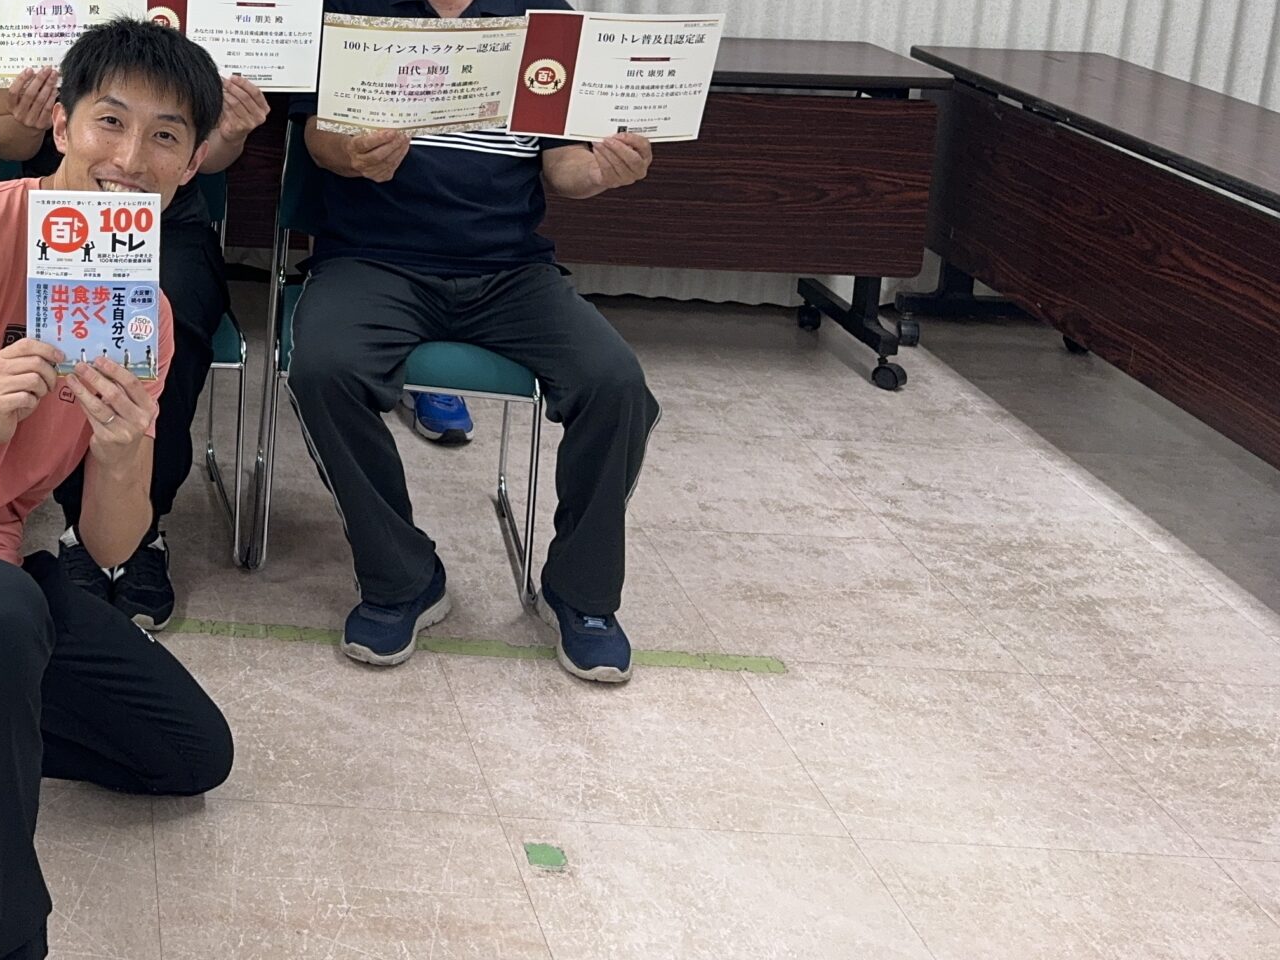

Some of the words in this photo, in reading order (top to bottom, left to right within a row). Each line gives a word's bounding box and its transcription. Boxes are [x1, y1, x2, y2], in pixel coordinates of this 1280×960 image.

[26, 5, 46, 16] 平山
[51, 4, 73, 16] 朋美
[89, 5, 100, 15] 殿
[235, 15, 251, 23] 平山
[343, 40, 512, 55] 100トレインストラクター認定証
[398, 65, 421, 75] 田代
[461, 64, 473, 74] 殿
[626, 69, 643, 78] 田代
[100, 207, 154, 233] 100
[111, 233, 146, 253] トレ
[70, 284, 90, 339] 食べる
[91, 285, 111, 324] 歩く
[112, 286, 126, 349] 一生自分で
[129, 323, 153, 335] DVD
